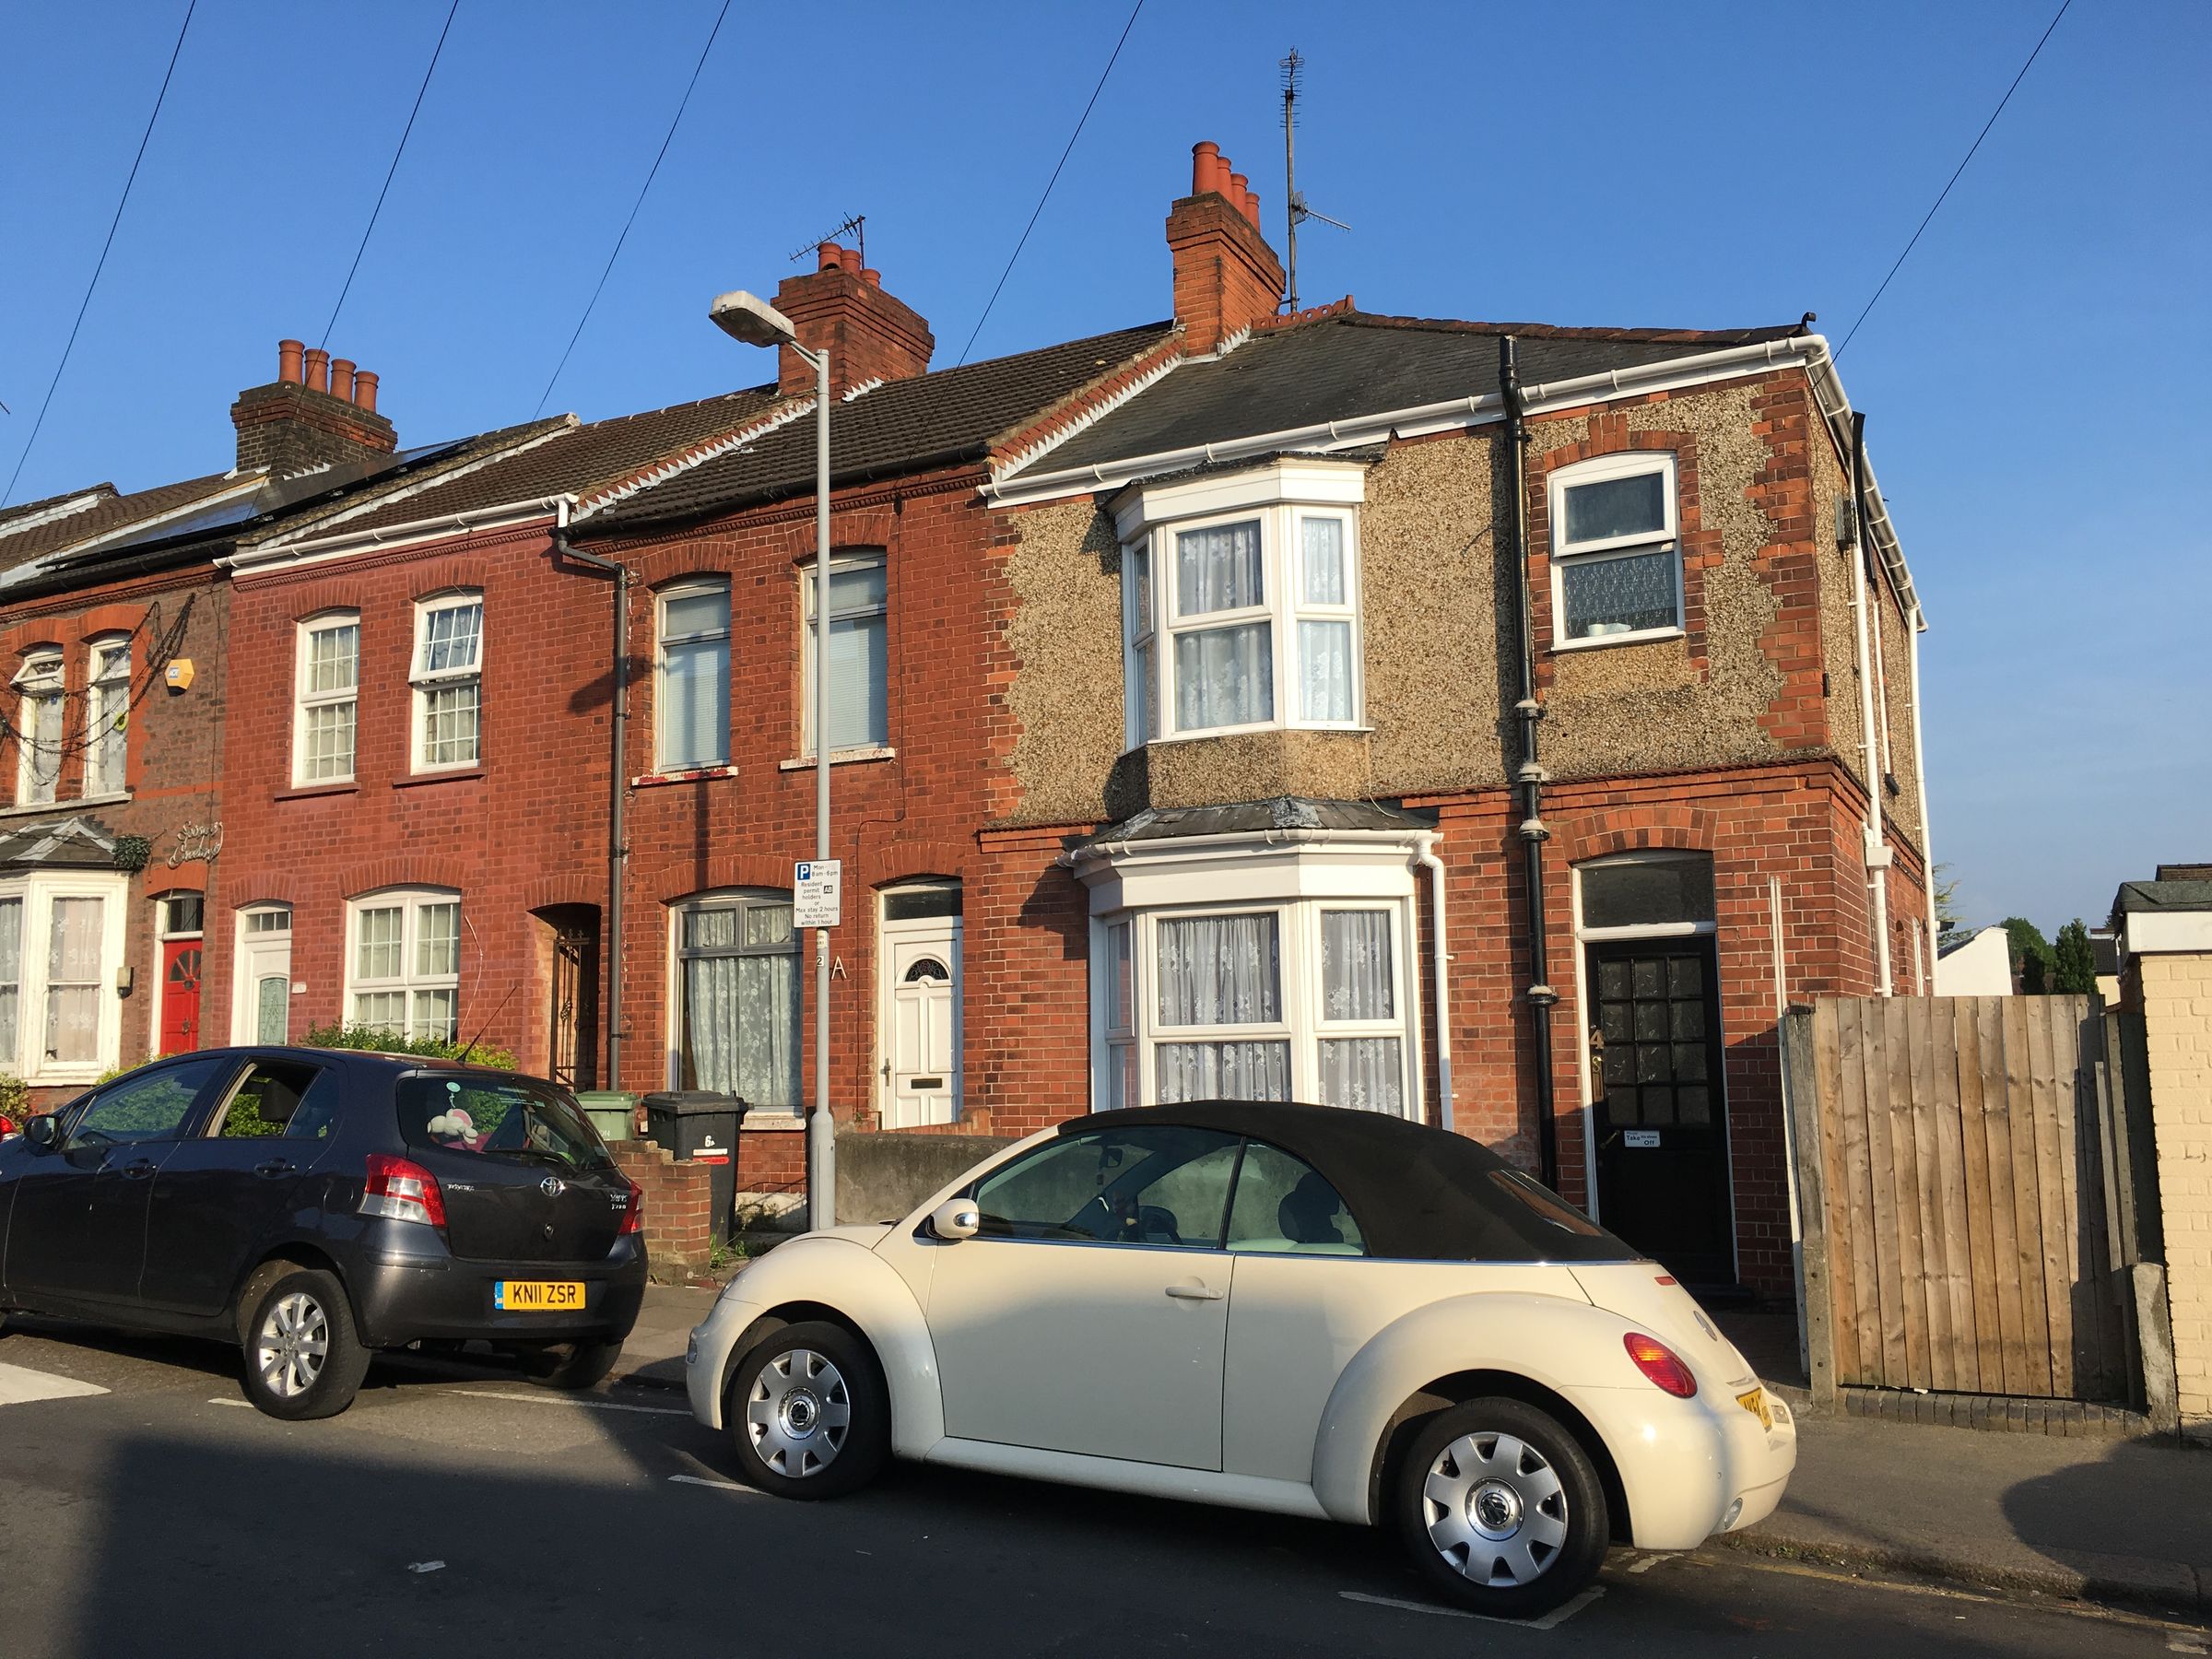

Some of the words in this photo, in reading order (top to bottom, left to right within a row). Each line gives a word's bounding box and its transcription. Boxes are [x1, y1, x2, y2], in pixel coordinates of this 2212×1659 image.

[800, 865, 809, 879] P
[1590, 1030, 1604, 1049] 4
[513, 1285, 542, 1303] KN11
[547, 1285, 576, 1303] ZSR
